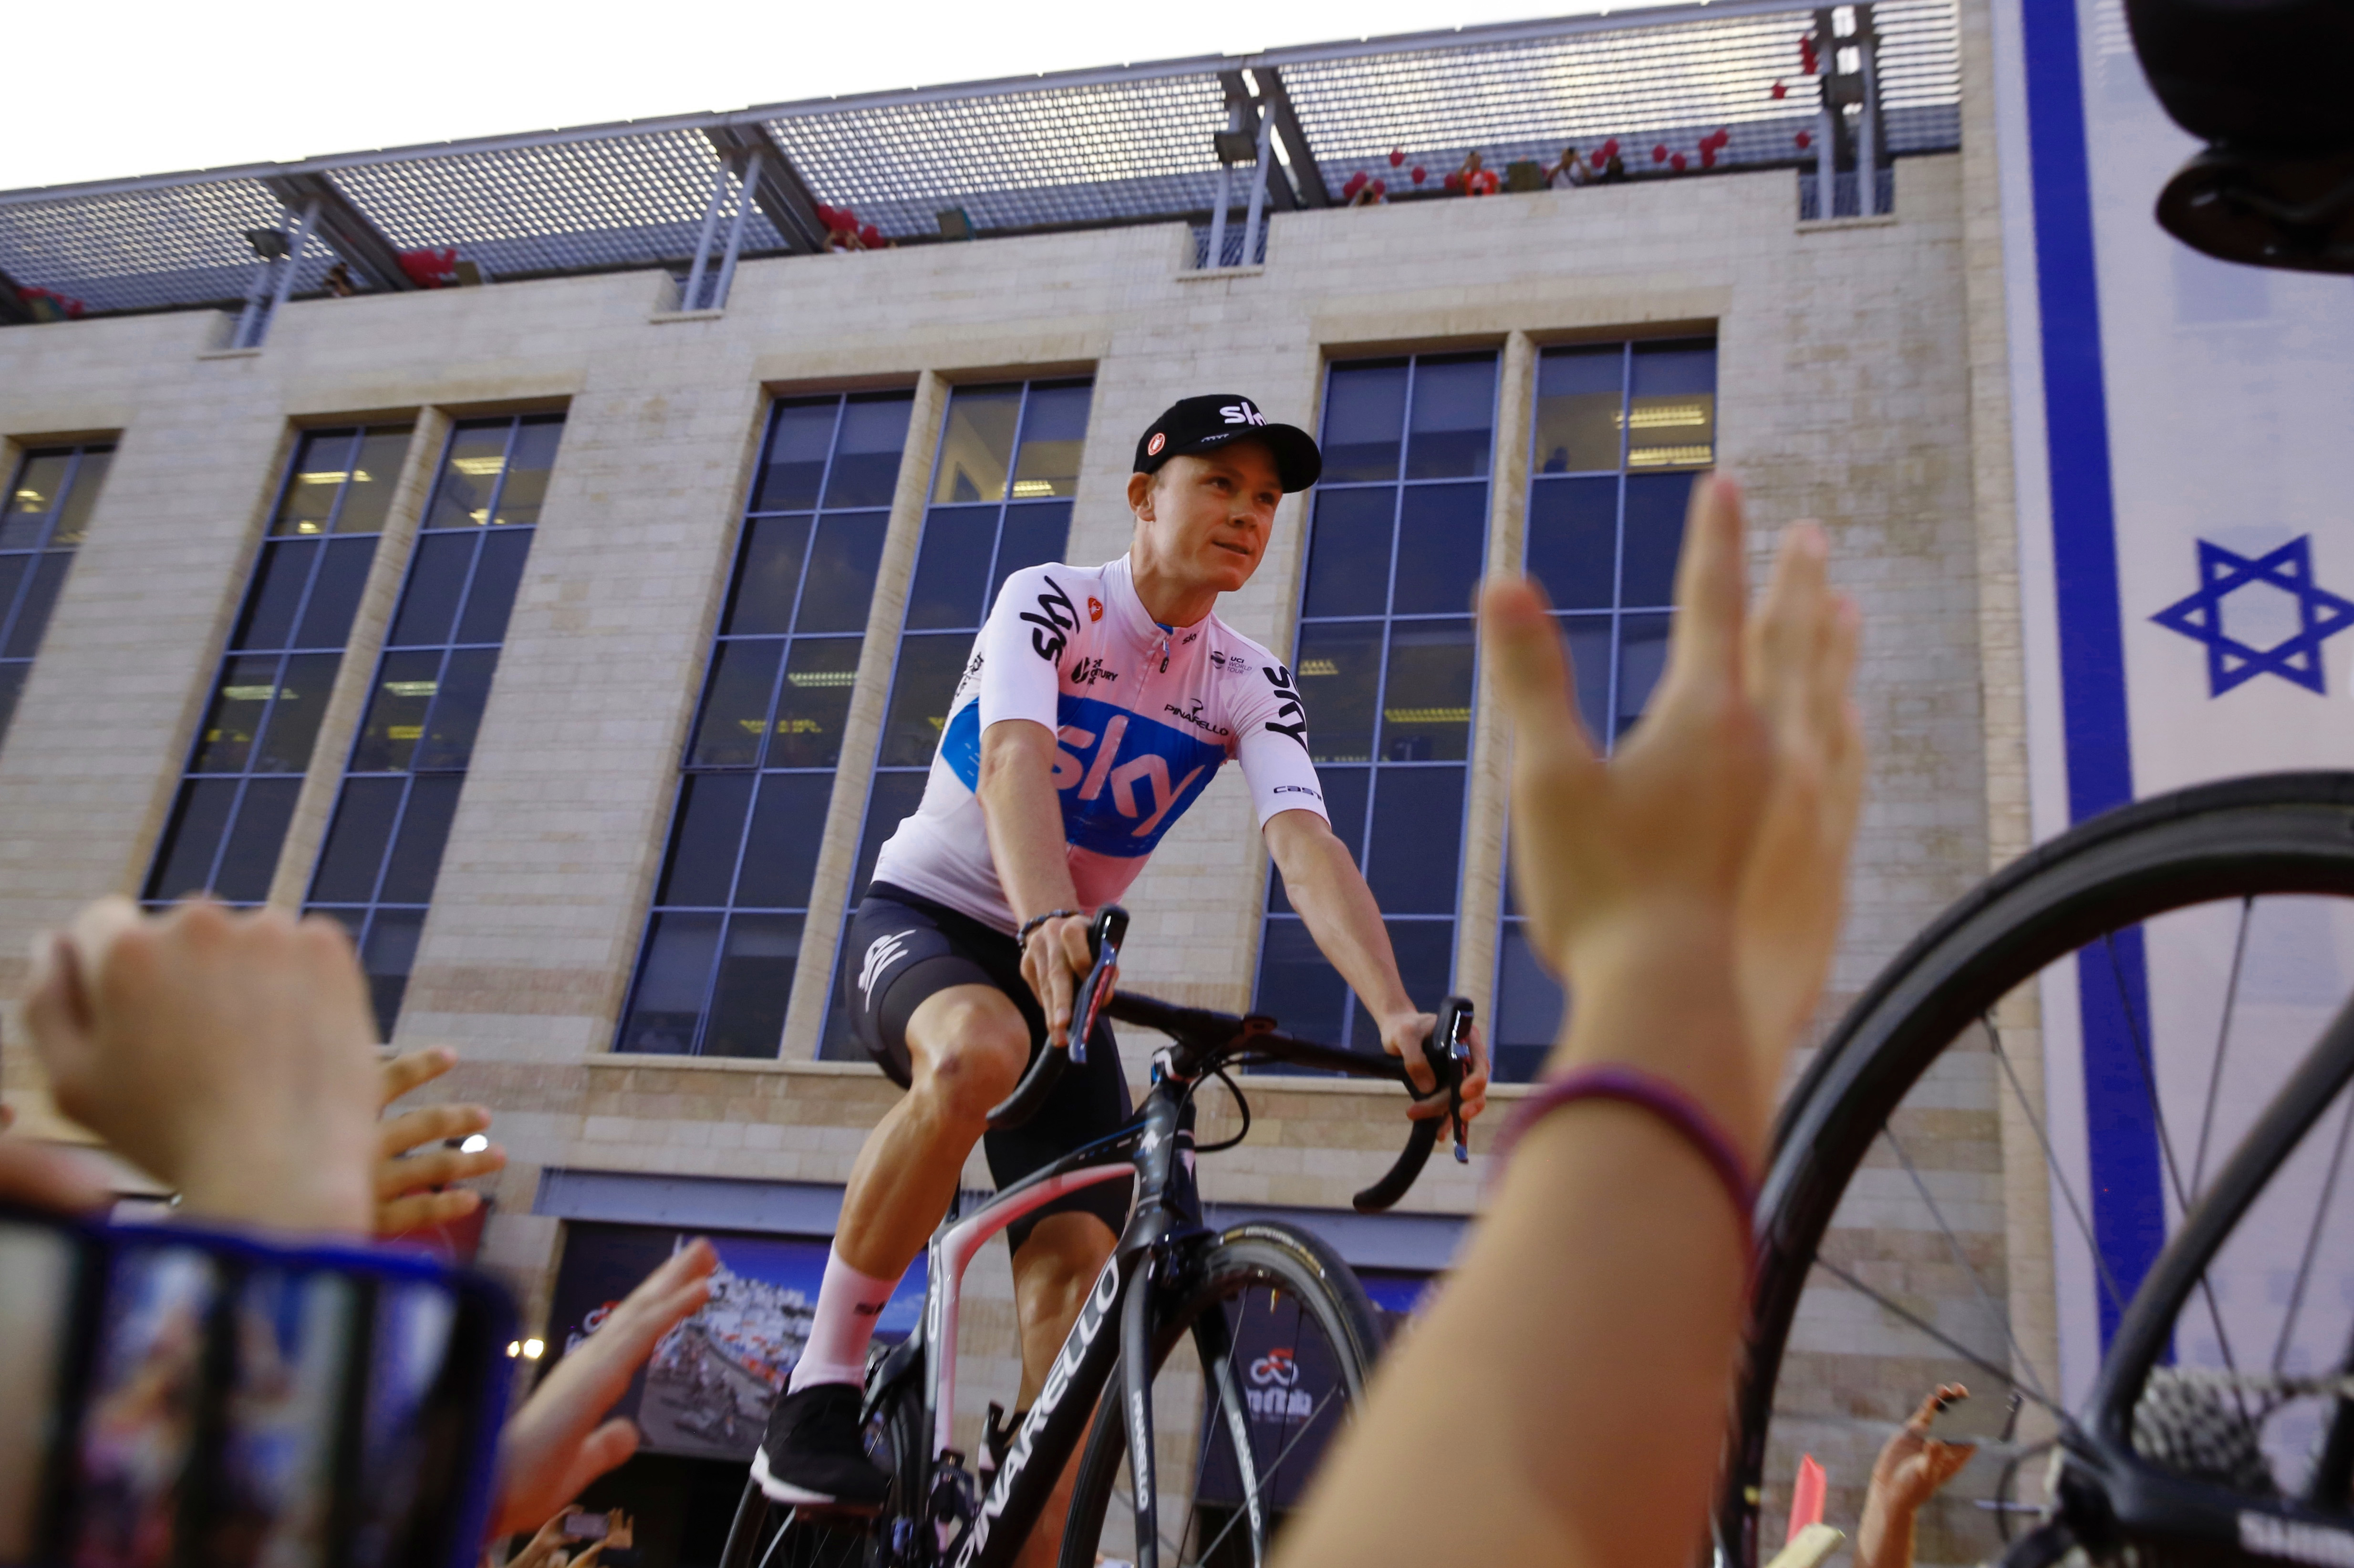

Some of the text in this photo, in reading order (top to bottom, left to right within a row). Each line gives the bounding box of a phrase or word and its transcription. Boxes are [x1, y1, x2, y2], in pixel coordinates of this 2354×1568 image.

[1020, 575, 1080, 670] sky
[1227, 666, 1244, 674] TOUR
[1229, 661, 1252, 671] WORLD
[1164, 703, 1229, 736] PINARELLO
[1051, 714, 1205, 836] sky
[954, 1254, 1119, 1568] PINARELLO
